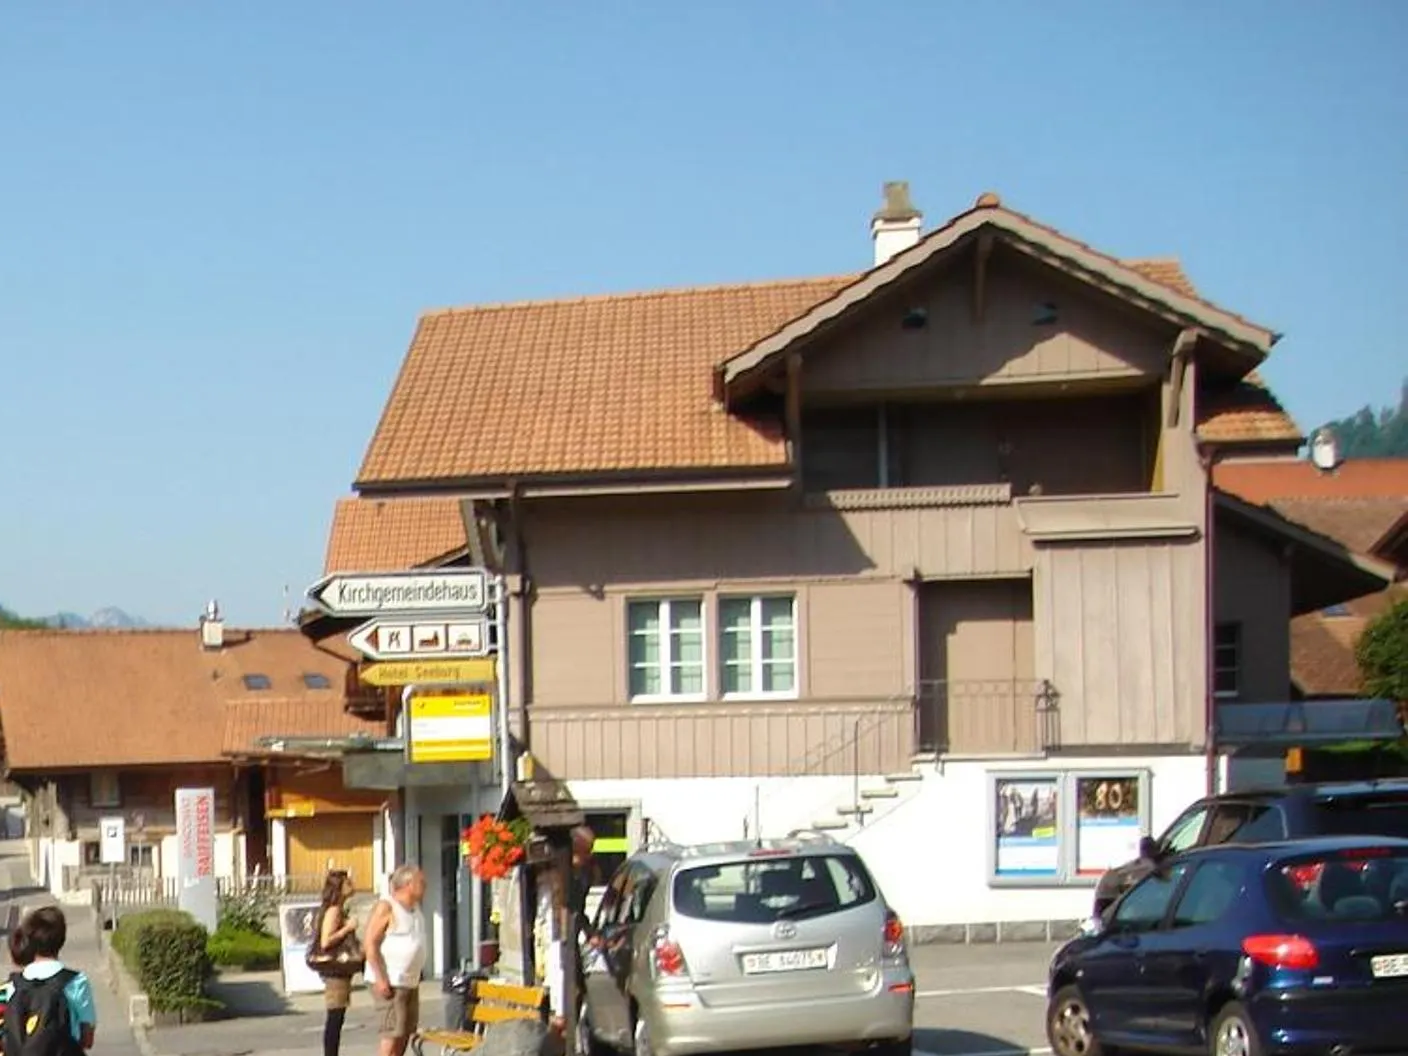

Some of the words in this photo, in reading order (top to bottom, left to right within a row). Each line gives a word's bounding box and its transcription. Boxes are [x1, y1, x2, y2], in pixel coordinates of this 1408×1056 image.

[337, 582, 478, 607] Kirchgemeindehaus
[378, 666, 408, 679] Hotel
[196, 796, 210, 876] RAIFFEISEN
